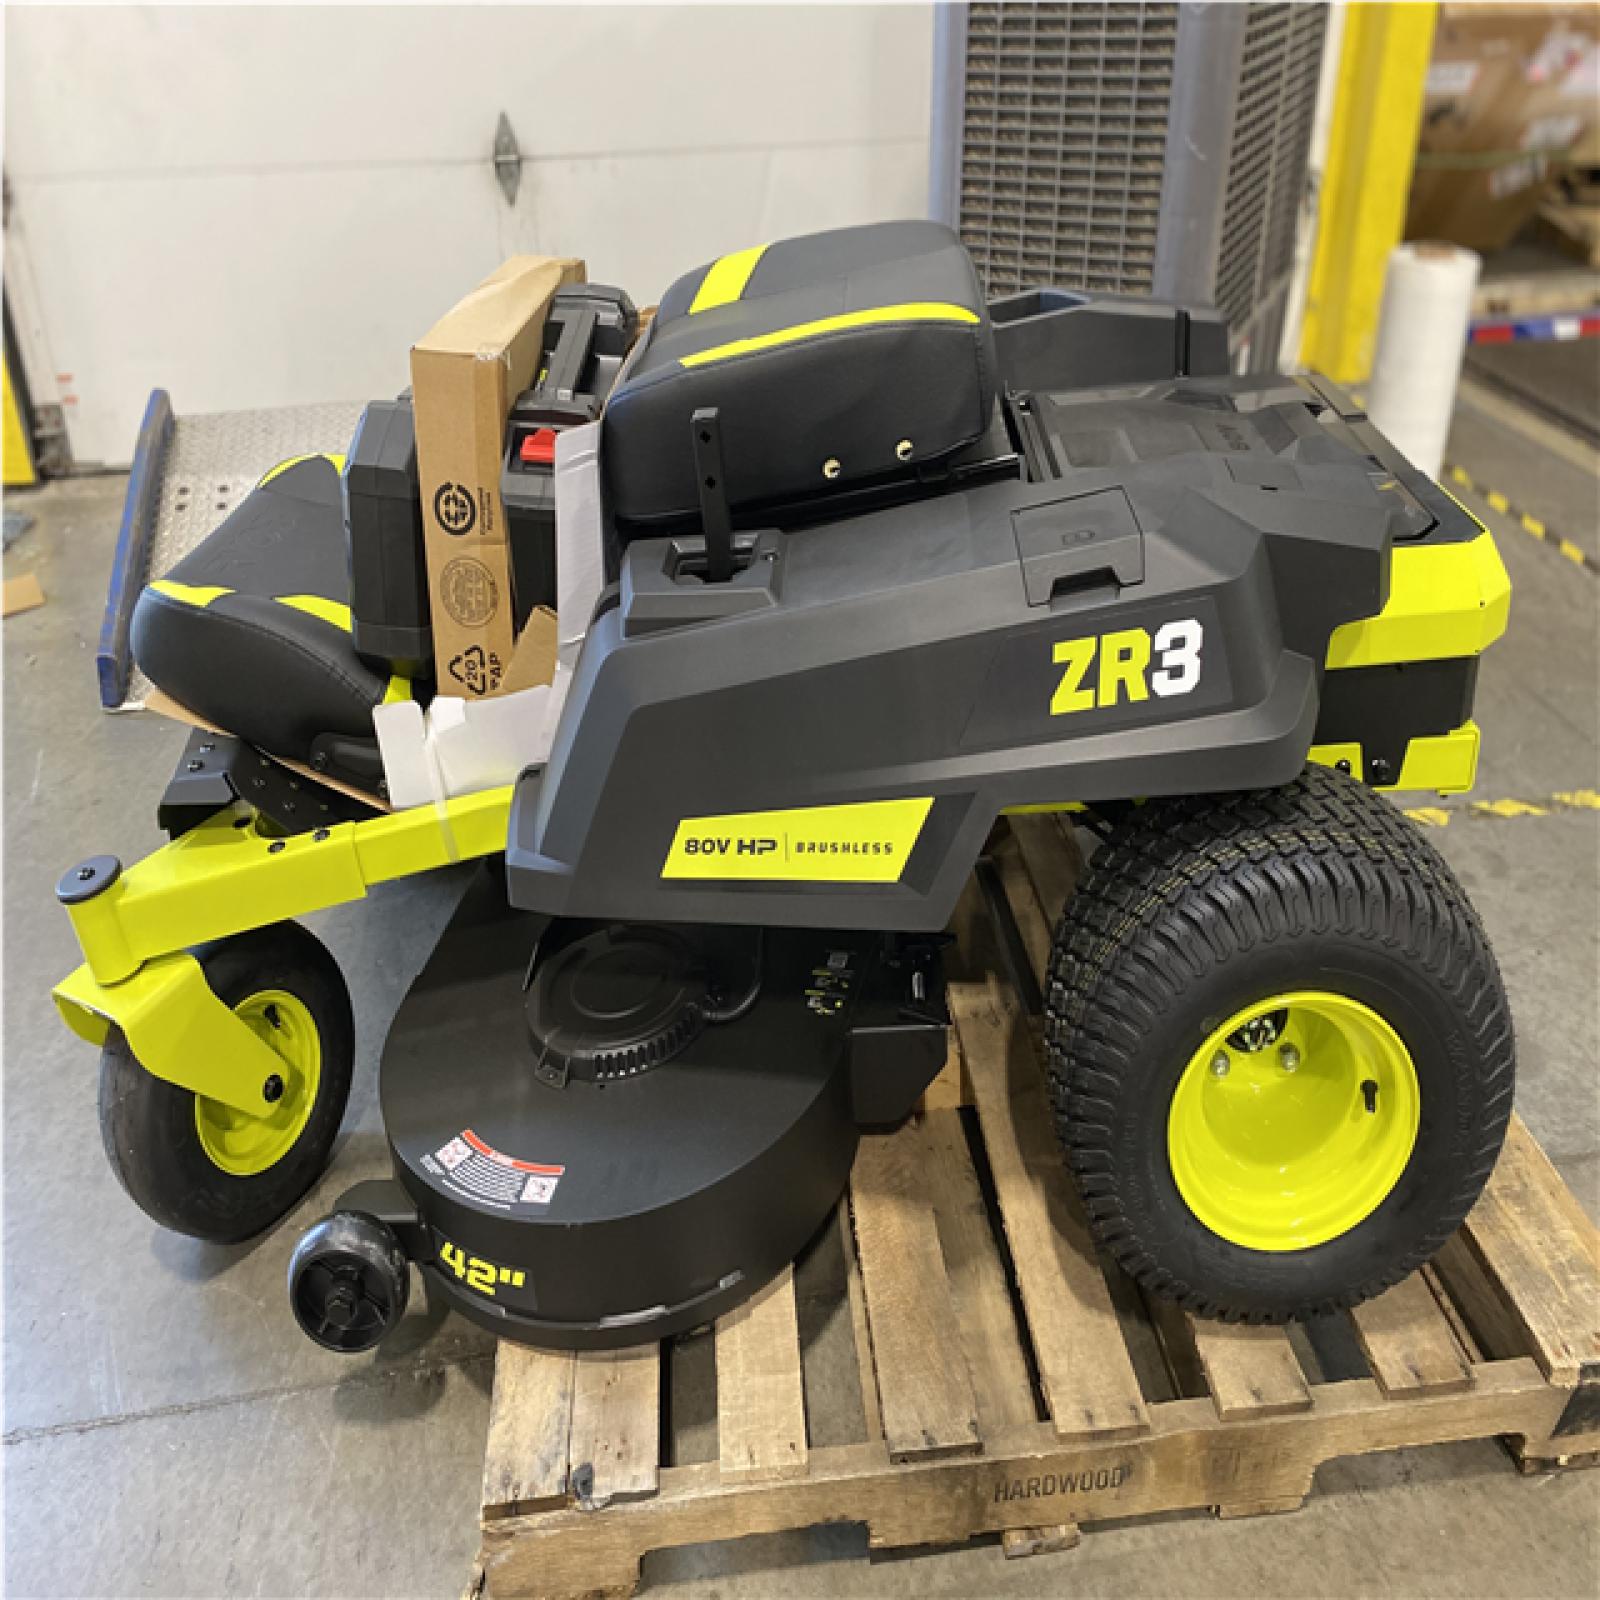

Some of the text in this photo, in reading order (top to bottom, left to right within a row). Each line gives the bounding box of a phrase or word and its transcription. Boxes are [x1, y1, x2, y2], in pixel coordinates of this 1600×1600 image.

[1051, 618, 1203, 715] ZR3
[684, 838, 893, 856] 80V HP BRUSHLESS
[440, 1242, 525, 1295] 42"
[994, 1466, 1124, 1503] HARDWOOD
